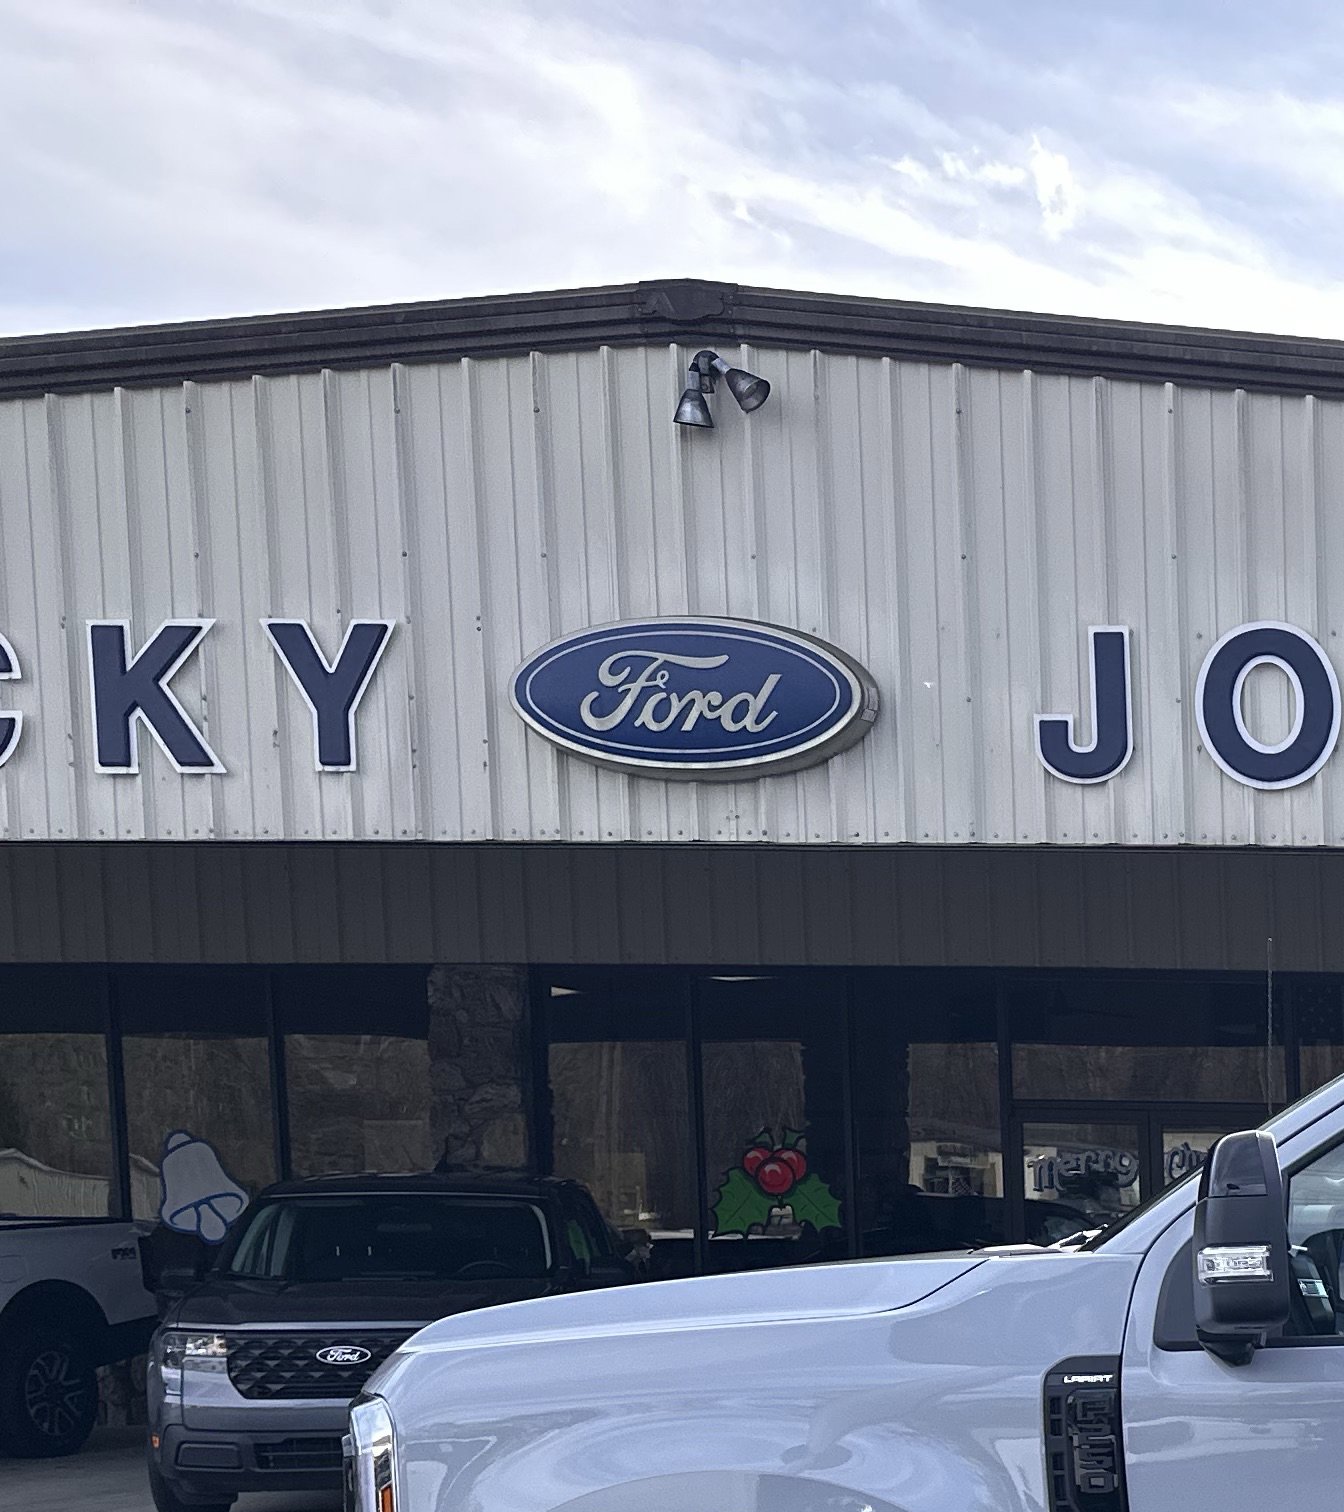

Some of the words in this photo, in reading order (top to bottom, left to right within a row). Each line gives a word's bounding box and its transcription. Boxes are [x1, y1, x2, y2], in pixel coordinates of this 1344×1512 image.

[0, 615, 396, 776] KY
[580, 649, 784, 735] Ford
[1063, 1374, 1113, 1384] LARIAT
